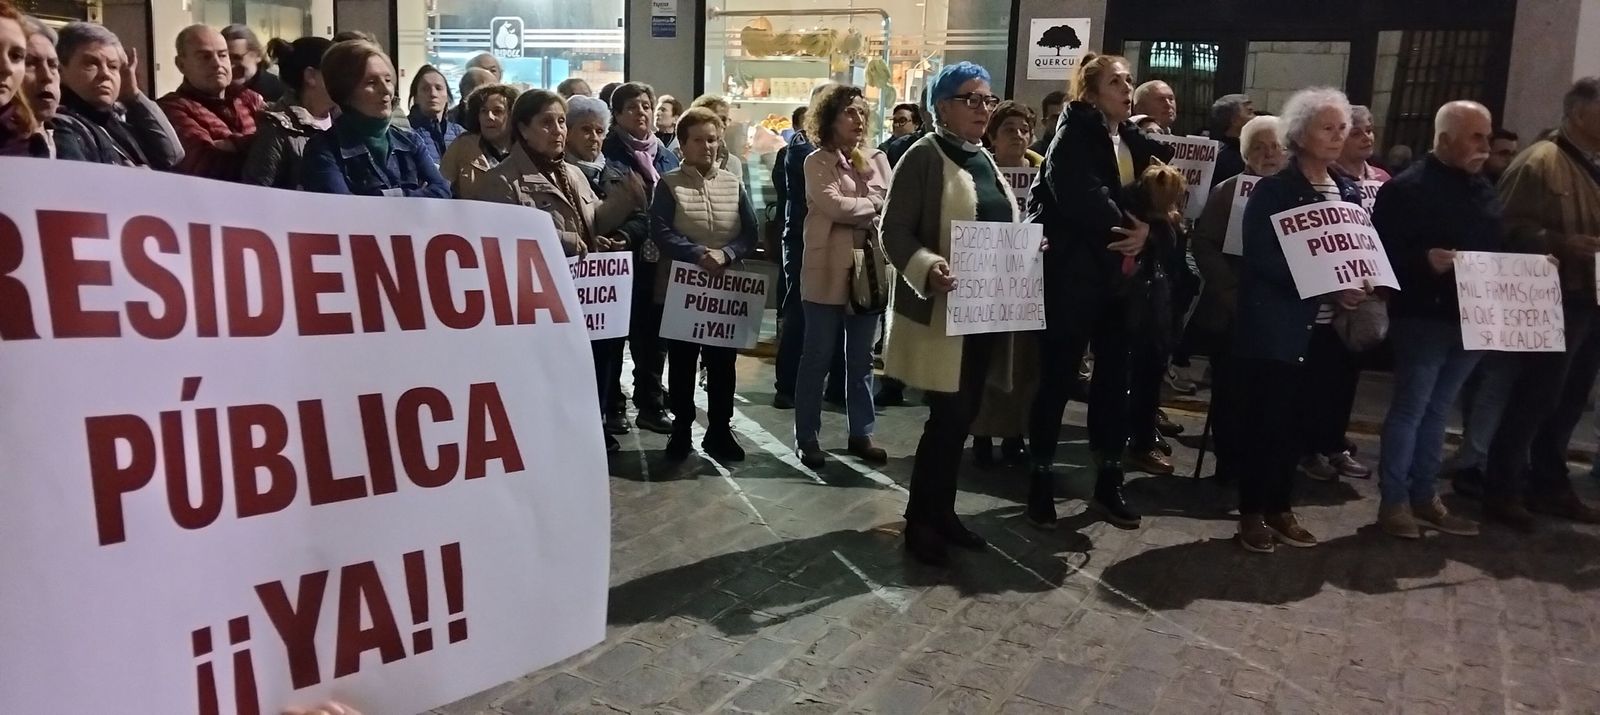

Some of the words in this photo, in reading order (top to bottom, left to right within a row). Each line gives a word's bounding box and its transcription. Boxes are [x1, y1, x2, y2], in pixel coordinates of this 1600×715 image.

[1279, 206, 1374, 236] RESIDENCIA
[954, 225, 1029, 250] POZOBLANCO
[1306, 231, 1378, 257] PÚBLICA
[569, 258, 630, 280] SIDENCIA
[953, 251, 998, 274] RECLAMA
[1005, 253, 1025, 273] UNA
[1334, 259, 1382, 284] ¡¡YA!!
[674, 267, 766, 295] RESIDENCIA
[1459, 281, 1482, 299] MIL
[577, 285, 617, 305] BLICA
[684, 292, 749, 317] PÚBLICA
[585, 312, 605, 331] A!!
[1461, 306, 1470, 324] A
[692, 320, 736, 340] ¡¡YA!!
[85, 376, 525, 546] PÚBLICA
[191, 542, 470, 715] ¡¡YA!!
